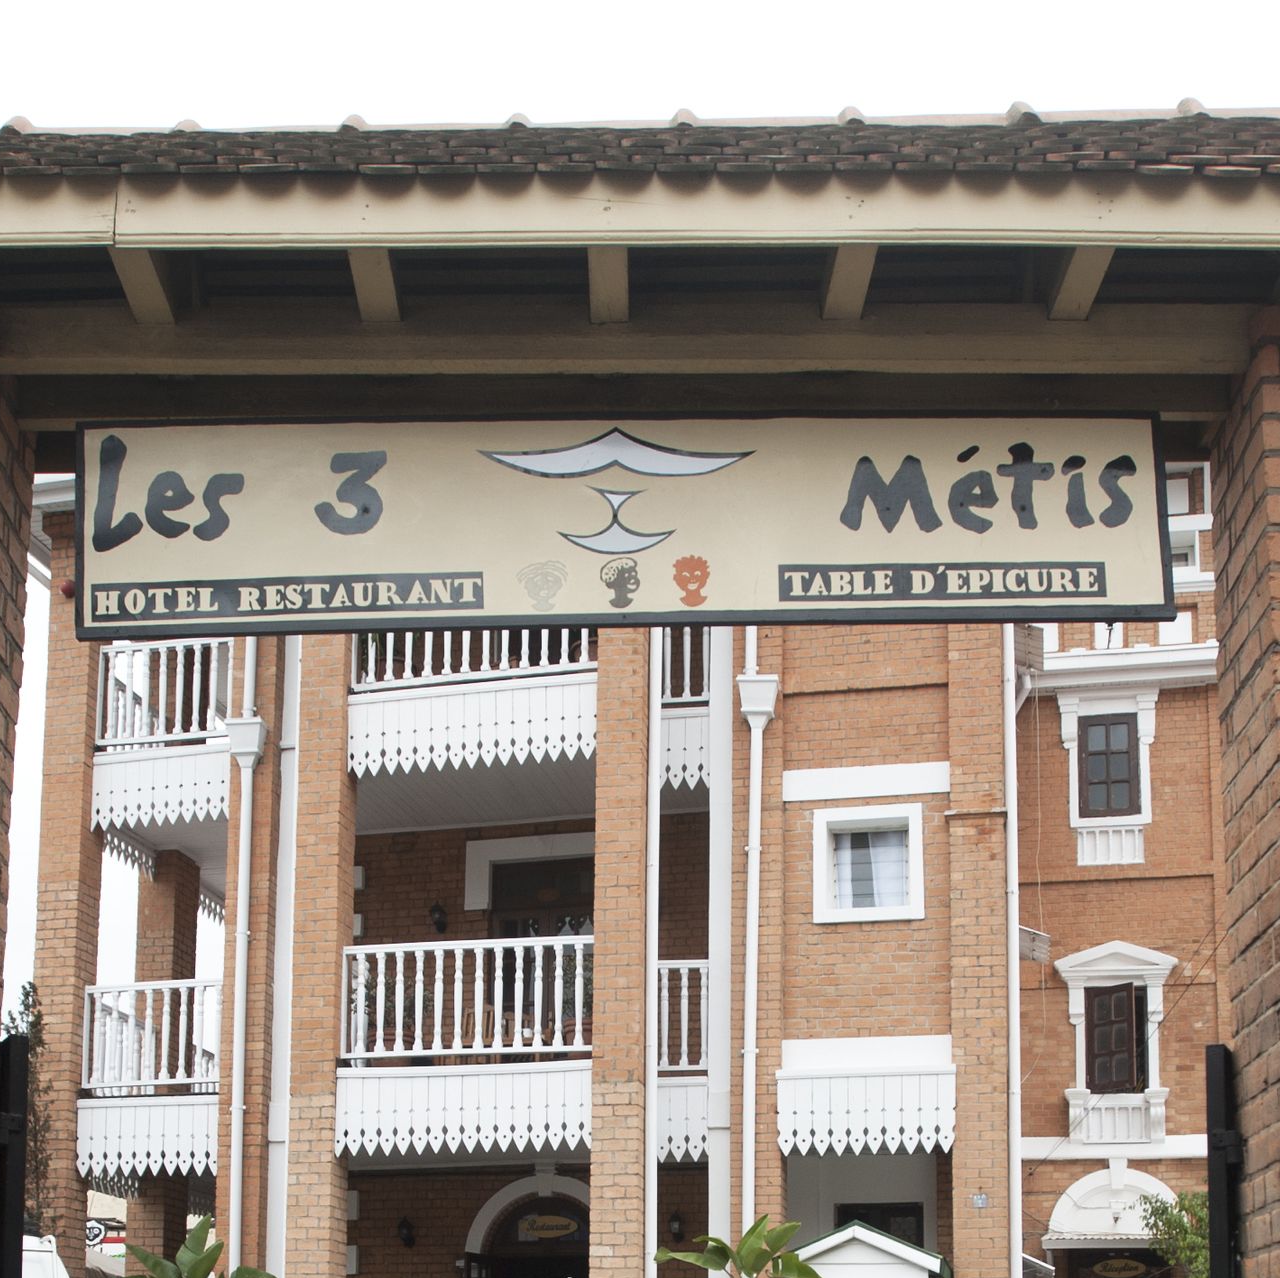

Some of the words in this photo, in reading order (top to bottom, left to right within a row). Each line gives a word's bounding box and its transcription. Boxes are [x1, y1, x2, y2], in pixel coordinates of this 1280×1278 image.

[92, 434, 244, 553] Les
[314, 450, 387, 535] 3
[840, 442, 1137, 534] Métis
[95, 586, 218, 616] HOTEL
[237, 577, 482, 612] RESTAURANT
[784, 570, 893, 596] TABLE
[910, 565, 1099, 594] D'EPICURE
